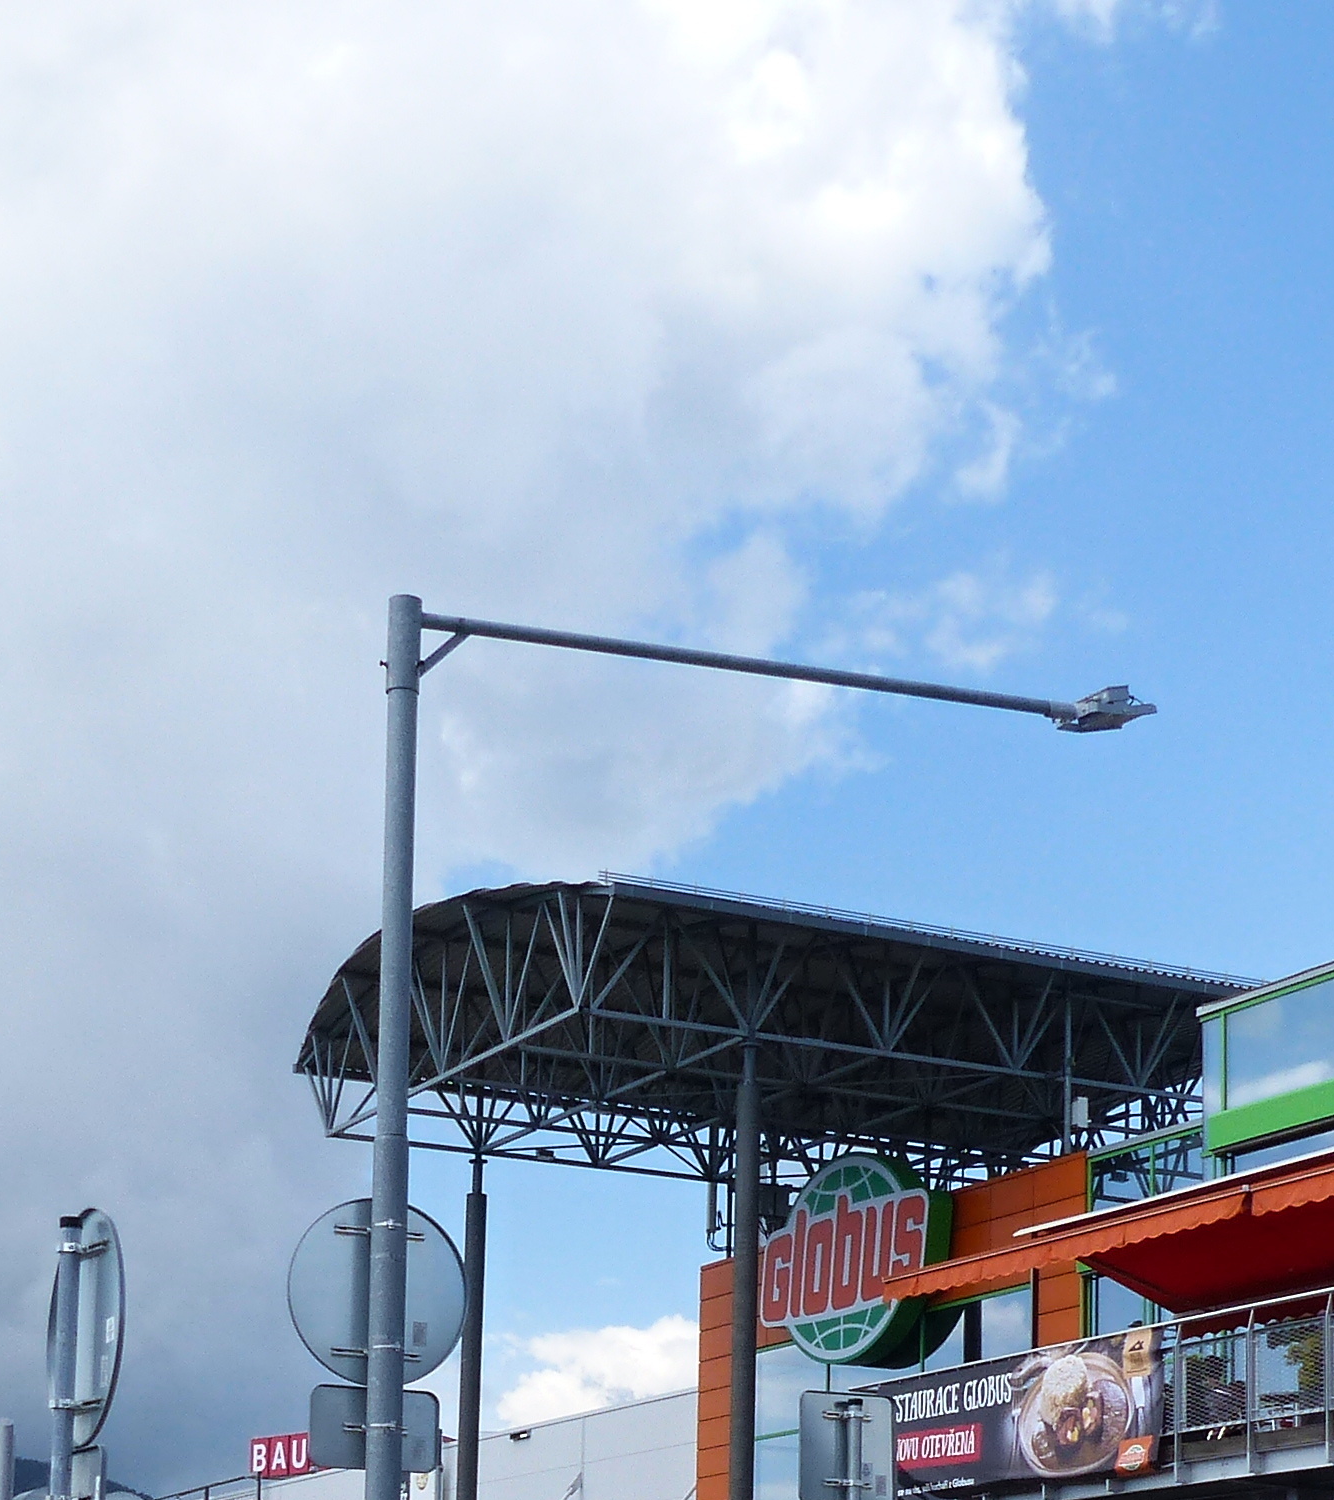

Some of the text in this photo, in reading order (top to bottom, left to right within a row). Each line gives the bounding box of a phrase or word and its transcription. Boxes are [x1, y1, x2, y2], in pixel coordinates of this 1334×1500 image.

[762, 1193, 926, 1323] Globus
[893, 1372, 1013, 1424] STAURACE GLOBUS
[922, 1424, 976, 1460] OTEVŘENÁ
